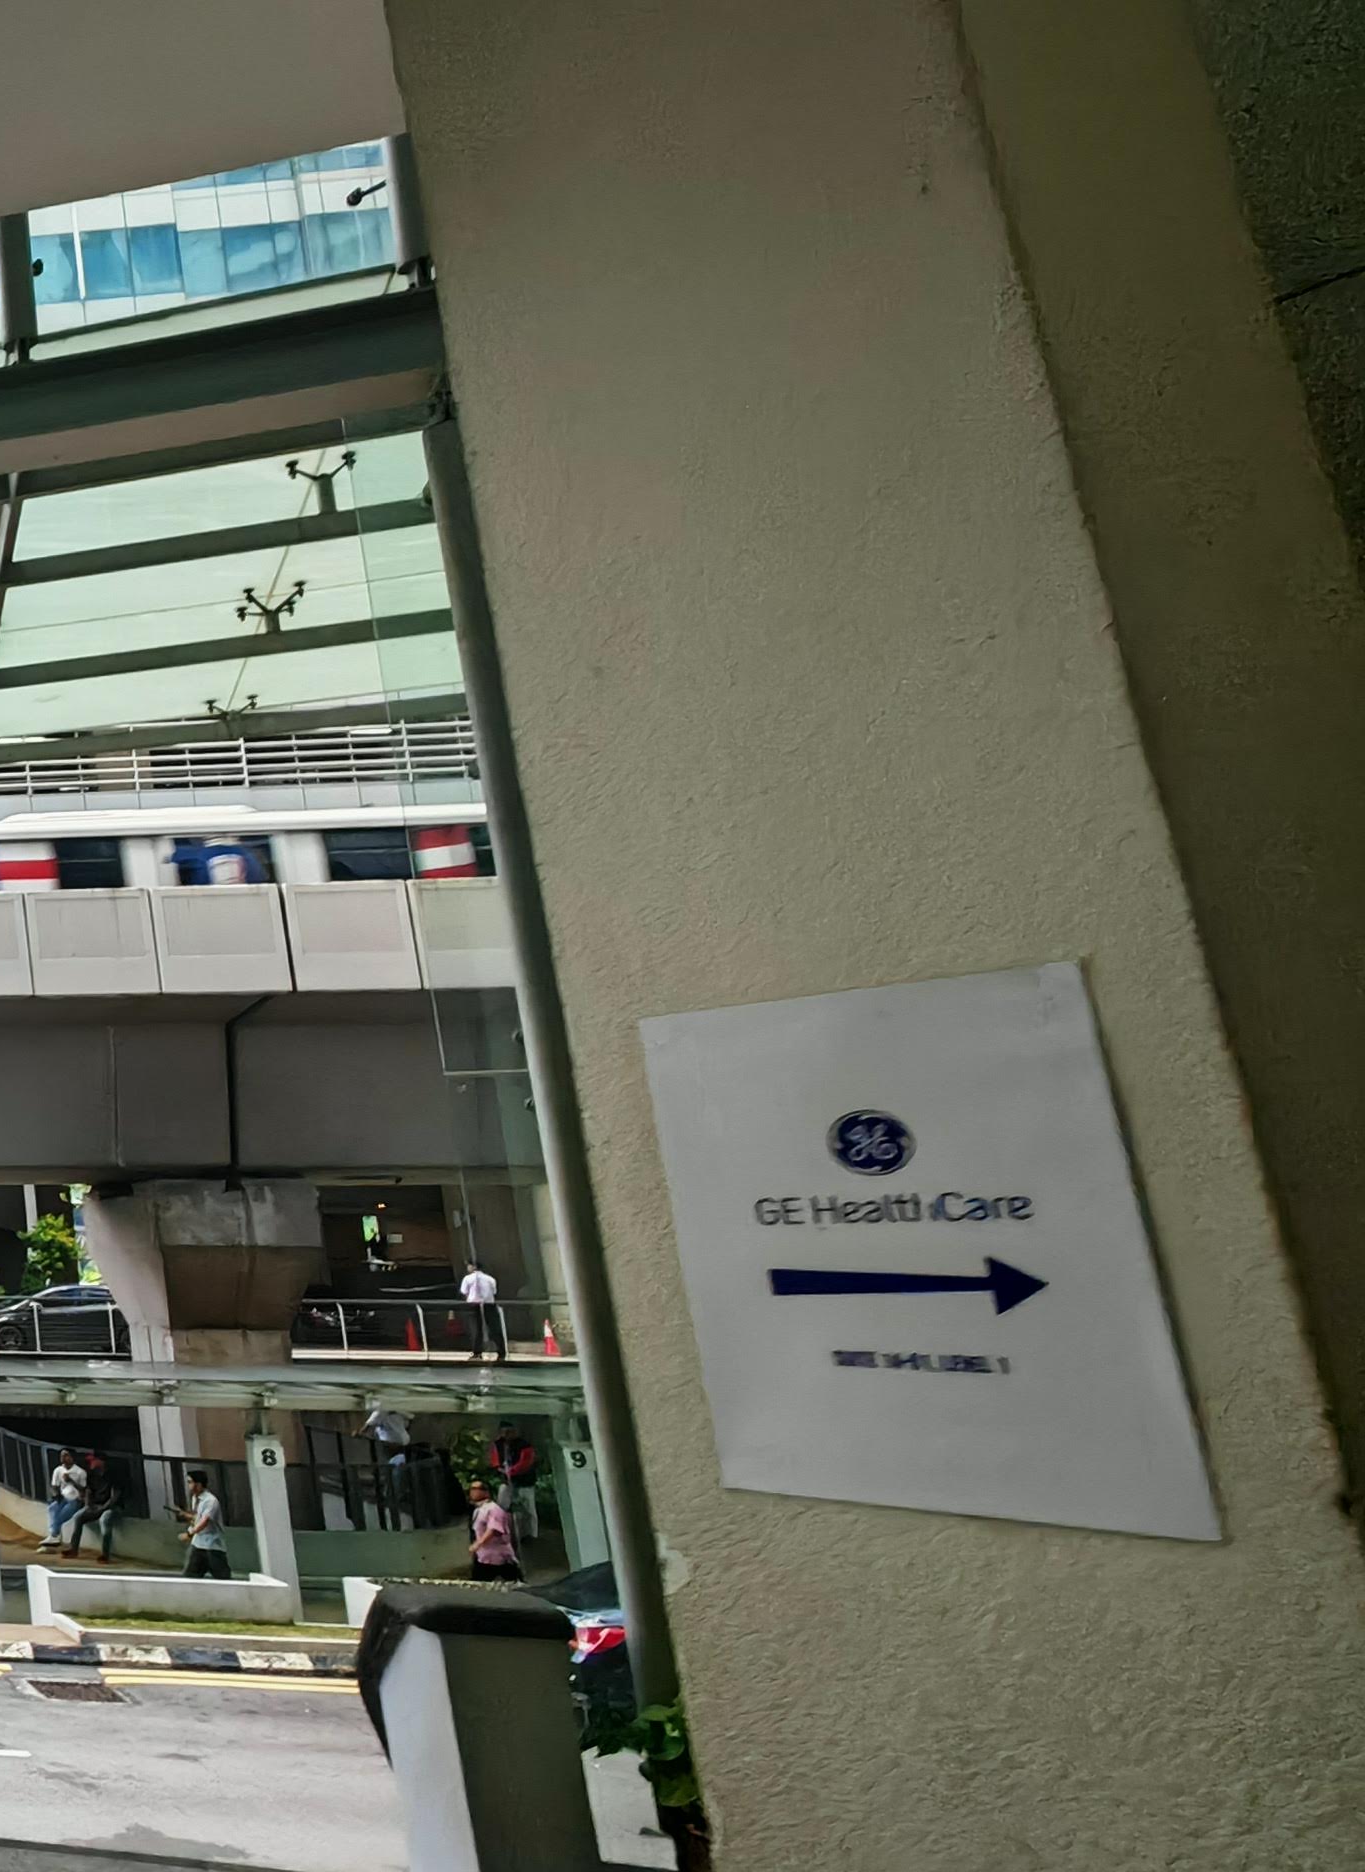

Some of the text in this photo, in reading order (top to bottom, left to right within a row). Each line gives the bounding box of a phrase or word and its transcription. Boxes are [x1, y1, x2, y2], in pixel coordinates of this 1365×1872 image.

[754, 1196, 805, 1226] GE
[261, 1447, 278, 1467] 8
[570, 1450, 587, 1469] 9
